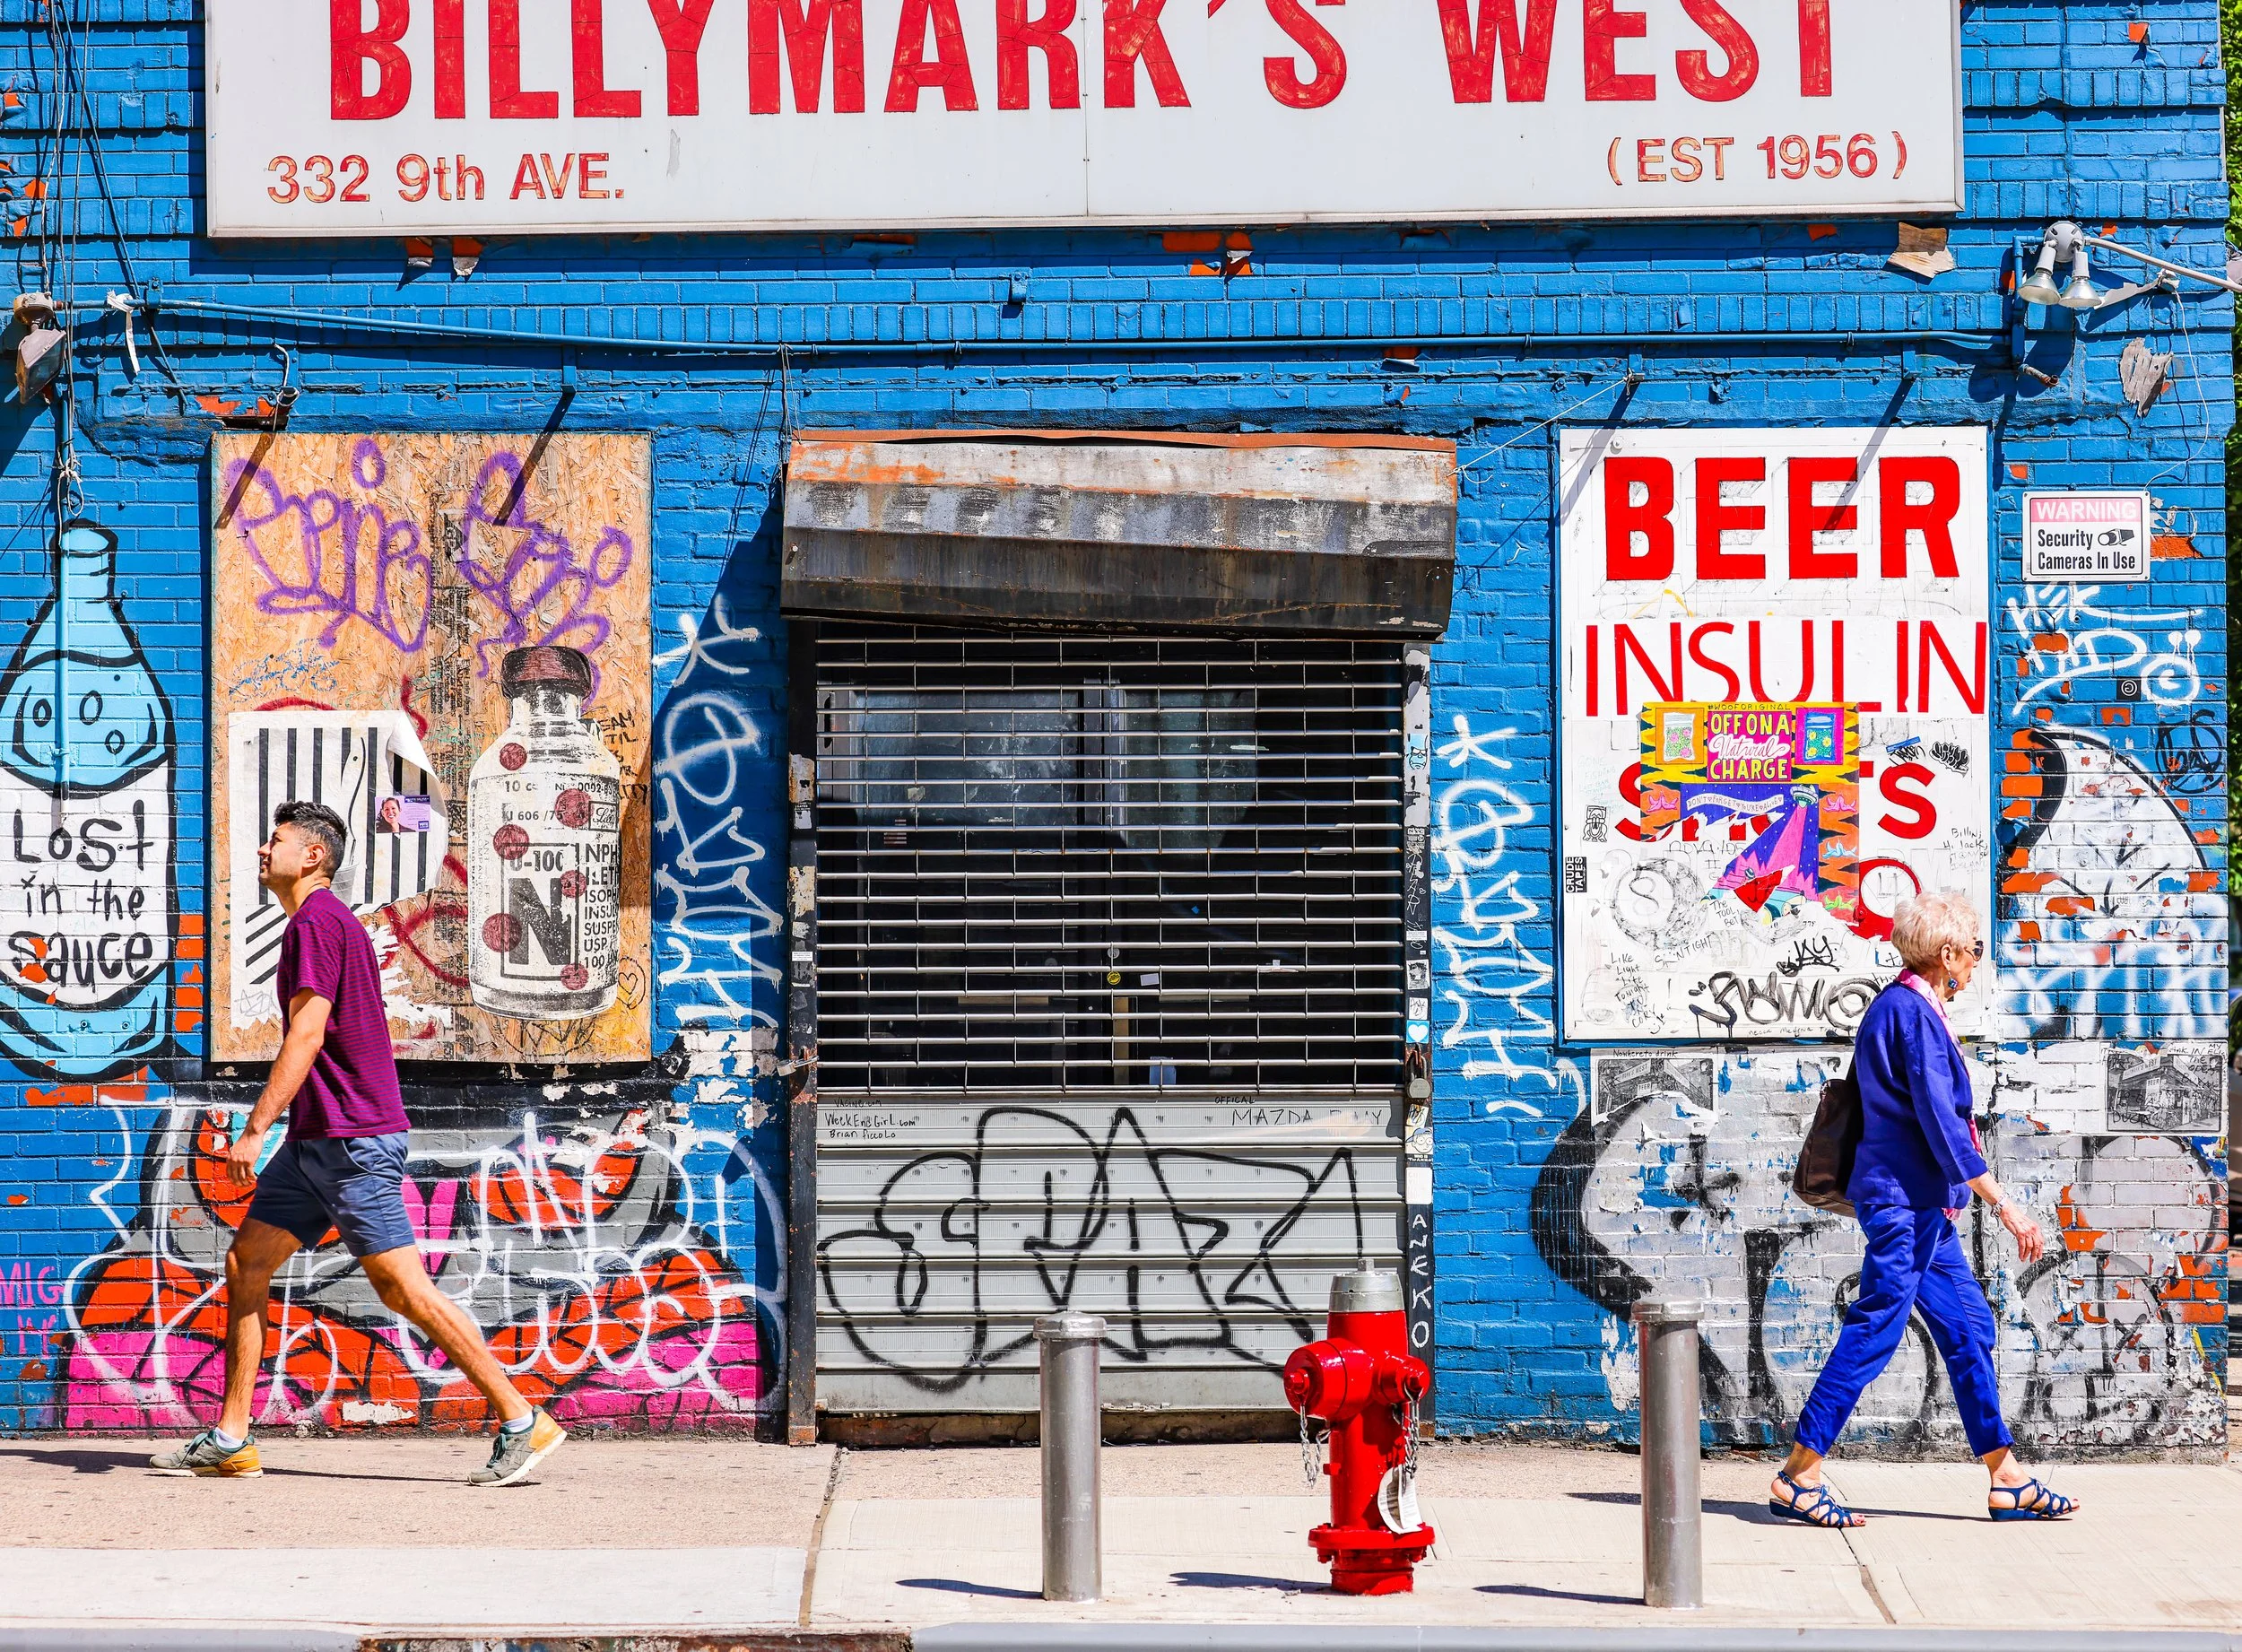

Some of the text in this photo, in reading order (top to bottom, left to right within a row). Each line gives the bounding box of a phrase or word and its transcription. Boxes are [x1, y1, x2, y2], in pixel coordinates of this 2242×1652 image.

[1440, 0, 1833, 102] WEST
[1607, 130, 1907, 186] (EST 1956)
[267, 152, 625, 203] 332 9th AVE.
[1603, 456, 1960, 582] BEER
[2036, 500, 2137, 520] WARNING
[2038, 528, 2093, 550] Security
[2038, 552, 2136, 570] Cameras In Use
[1585, 620, 1987, 717] INSULIN
[1710, 713, 1791, 735] OFF ON A
[1712, 735, 1786, 758] Natural
[1710, 759, 1790, 780] CHARGE
[503, 780, 521, 793] 10
[517, 811, 539, 821] 606
[586, 843, 618, 863] NPH
[1566, 856, 1575, 892] CRUDE
[1575, 856, 1584, 892] TAPES
[21, 874, 144, 921] in the
[508, 877, 572, 966] N
[8, 930, 153, 993] sauce
[1231, 1109, 1314, 1126] MAZDA
